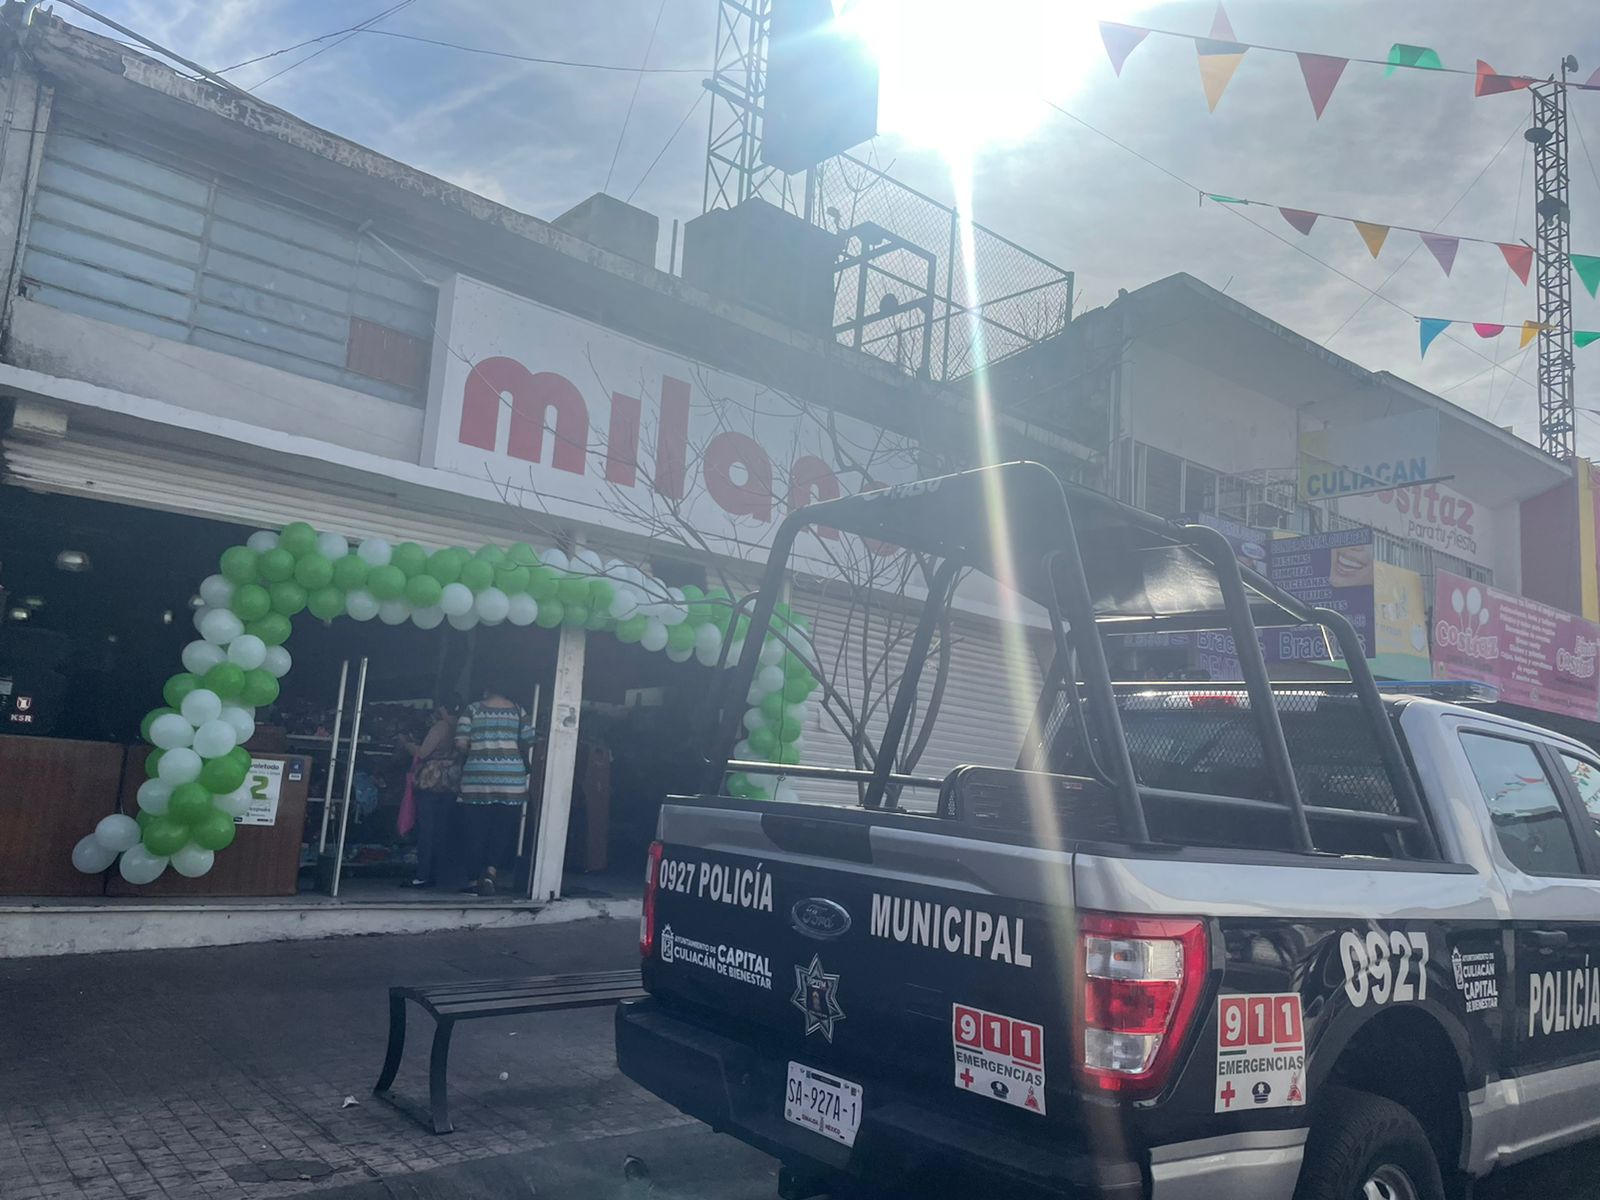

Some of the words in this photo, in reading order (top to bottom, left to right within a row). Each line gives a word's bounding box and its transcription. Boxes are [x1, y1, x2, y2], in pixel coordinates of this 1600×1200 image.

[459, 356, 904, 558] milan
[1307, 456, 1427, 496] CULIACAN
[1361, 484, 1475, 535] ositaz
[1280, 631, 1366, 659] Bracks
[250, 775, 269, 800] 2
[659, 858, 696, 894] 0927
[698, 862, 773, 912] POLICÍA
[870, 893, 1033, 968] MUNICIPAL
[674, 946, 716, 971] CULIACÁN
[717, 944, 773, 978] CAPITAL
[717, 962, 728, 976] DE
[728, 965, 773, 991] BIENESTAR
[1340, 931, 1430, 1007] 0927
[1464, 979, 1499, 1000] CAPITAL
[1528, 954, 1600, 1037] POLICÍA
[960, 1015, 1032, 1057] 911
[1225, 1002, 1293, 1041] 911
[956, 1051, 1042, 1087] EMERGENCIAS
[1218, 1055, 1304, 1075] EMERGENCIAS
[788, 1078, 856, 1127] SA-927A-1
